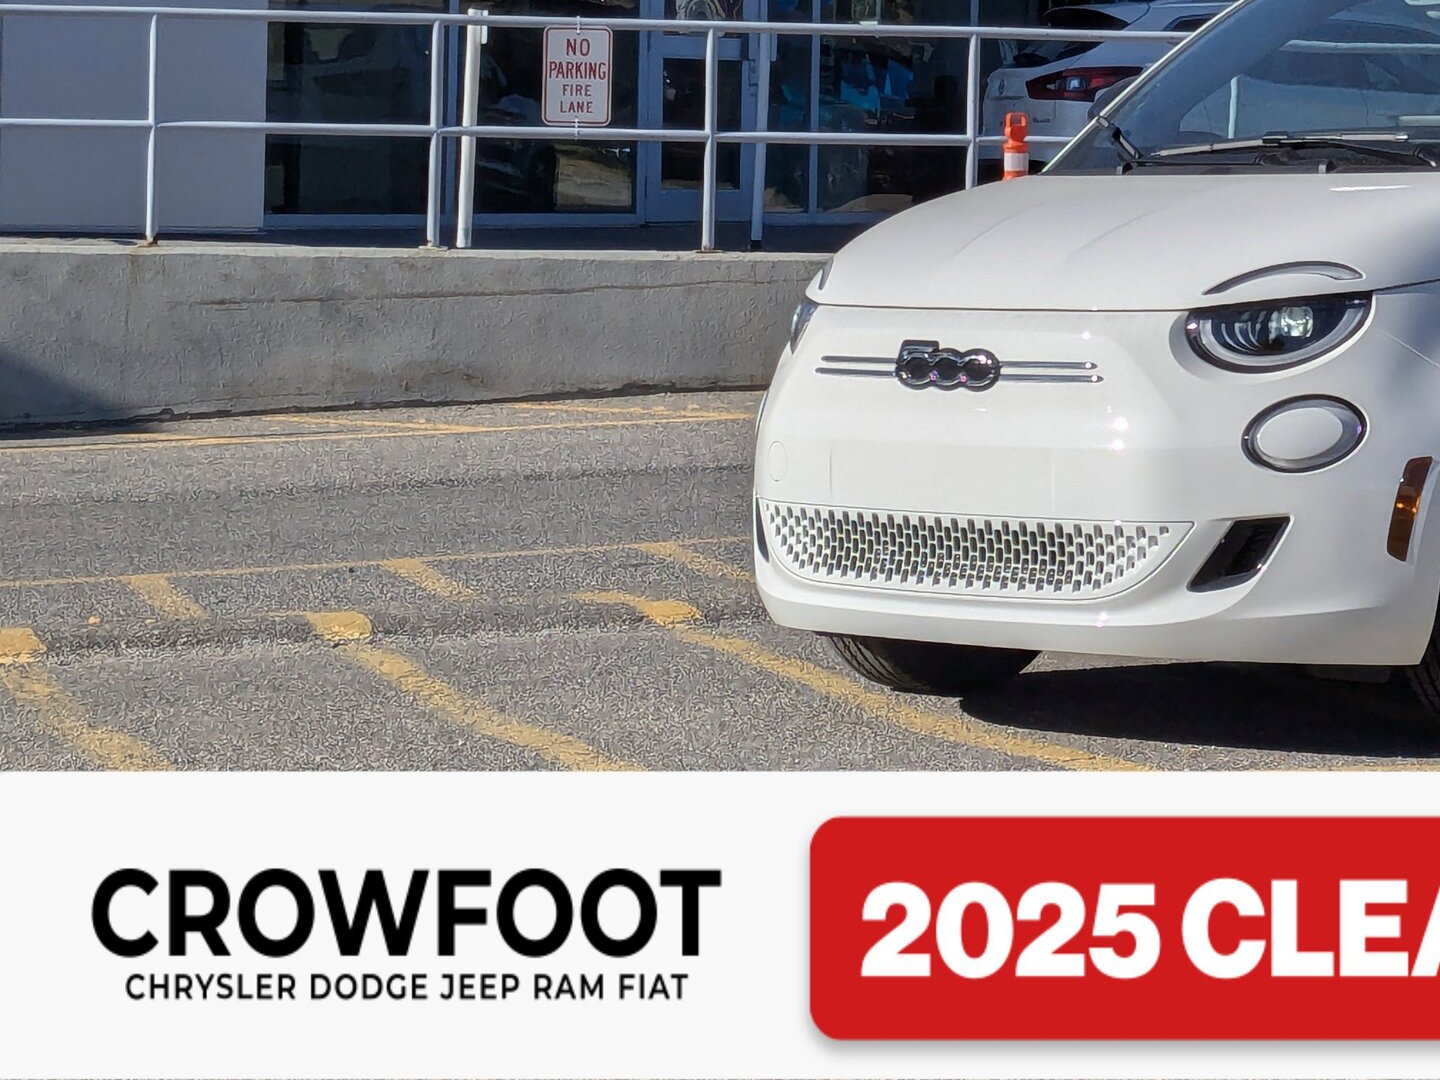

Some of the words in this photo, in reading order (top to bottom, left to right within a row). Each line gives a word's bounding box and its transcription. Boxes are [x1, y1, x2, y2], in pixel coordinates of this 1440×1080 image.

[566, 38, 590, 56] NO
[549, 61, 606, 80] PARKING
[563, 84, 592, 96] FIRE
[561, 101, 593, 113] LANE
[896, 339, 1001, 392] 500
